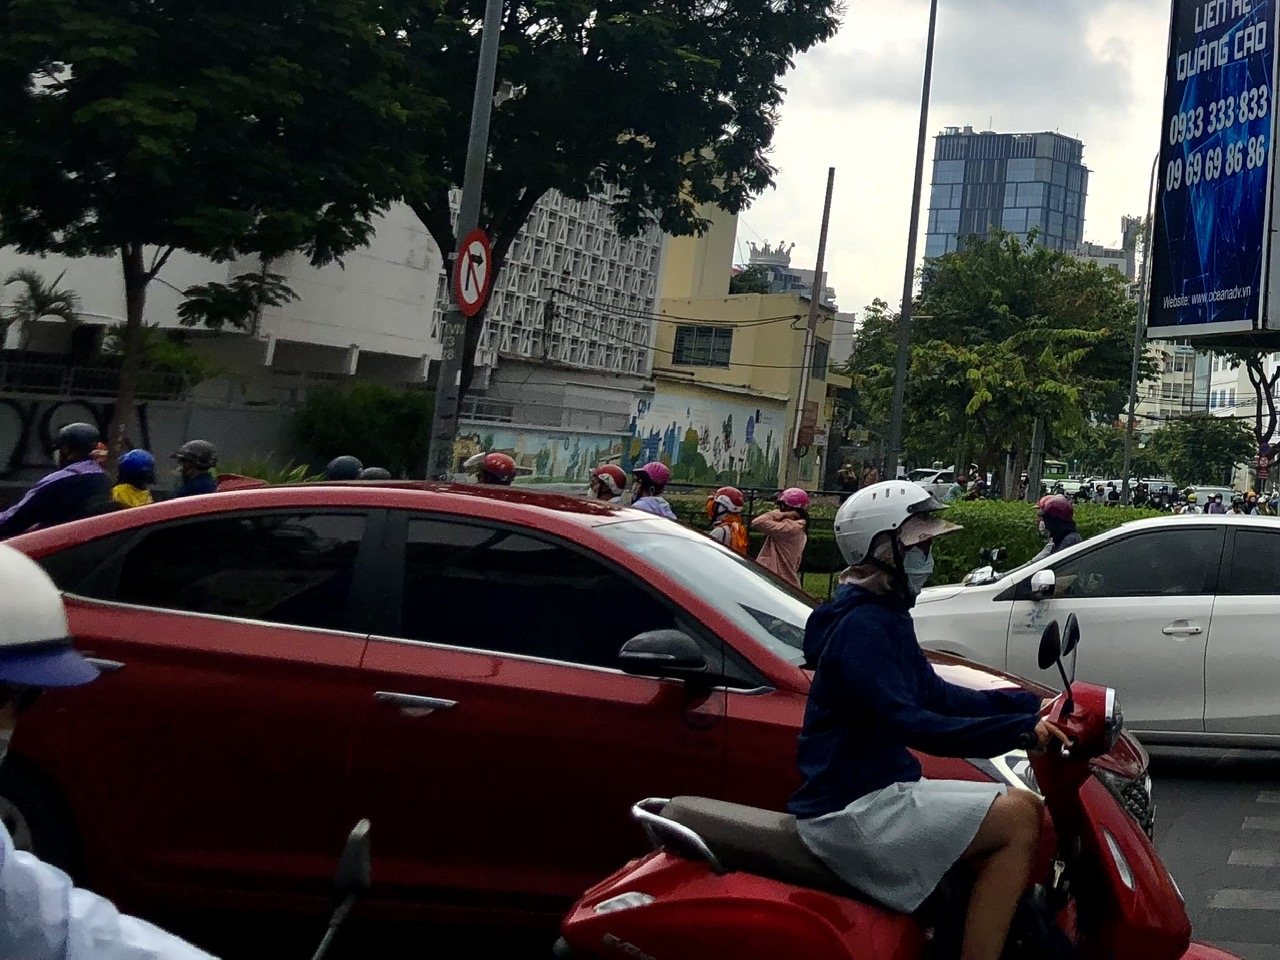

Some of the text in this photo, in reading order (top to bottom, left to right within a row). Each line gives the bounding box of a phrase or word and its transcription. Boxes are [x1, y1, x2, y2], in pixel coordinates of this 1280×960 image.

[1177, 21, 1267, 81] QUẢNG CÁO
[1169, 84, 1268, 146] 0933 333 833
[1166, 134, 1265, 191] 09 69 69 86 86
[1163, 284, 1251, 309] Website: www.oceanadv.vn
